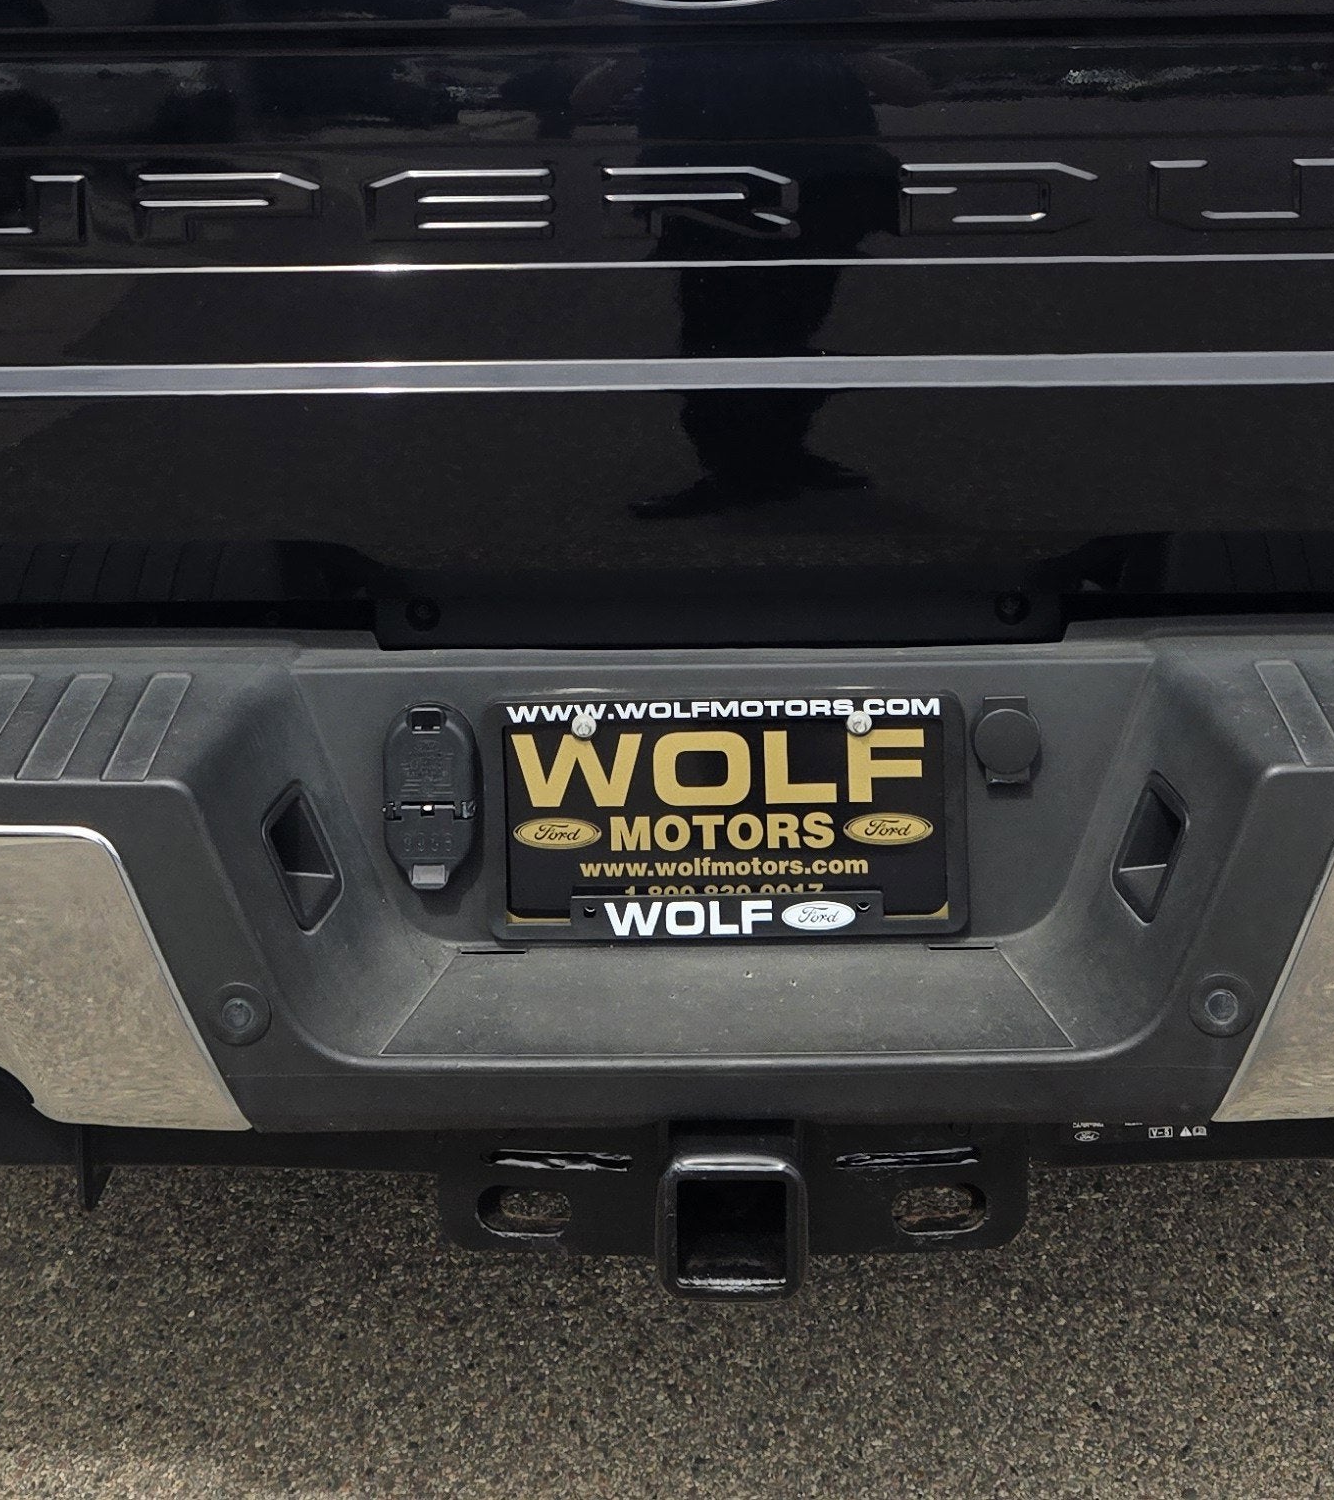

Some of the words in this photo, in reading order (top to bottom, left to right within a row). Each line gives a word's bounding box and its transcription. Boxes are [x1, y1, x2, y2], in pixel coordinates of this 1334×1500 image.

[506, 698, 941, 723] WWW.WOLFMOTORSCOM
[511, 729, 925, 808] WOLF
[534, 824, 581, 841] Ford
[610, 812, 835, 851] MOTORS
[864, 818, 912, 837] Ford
[579, 857, 869, 878] www.wolfmotors.com
[603, 900, 773, 937] WOLF
[798, 906, 840, 923] Ford
